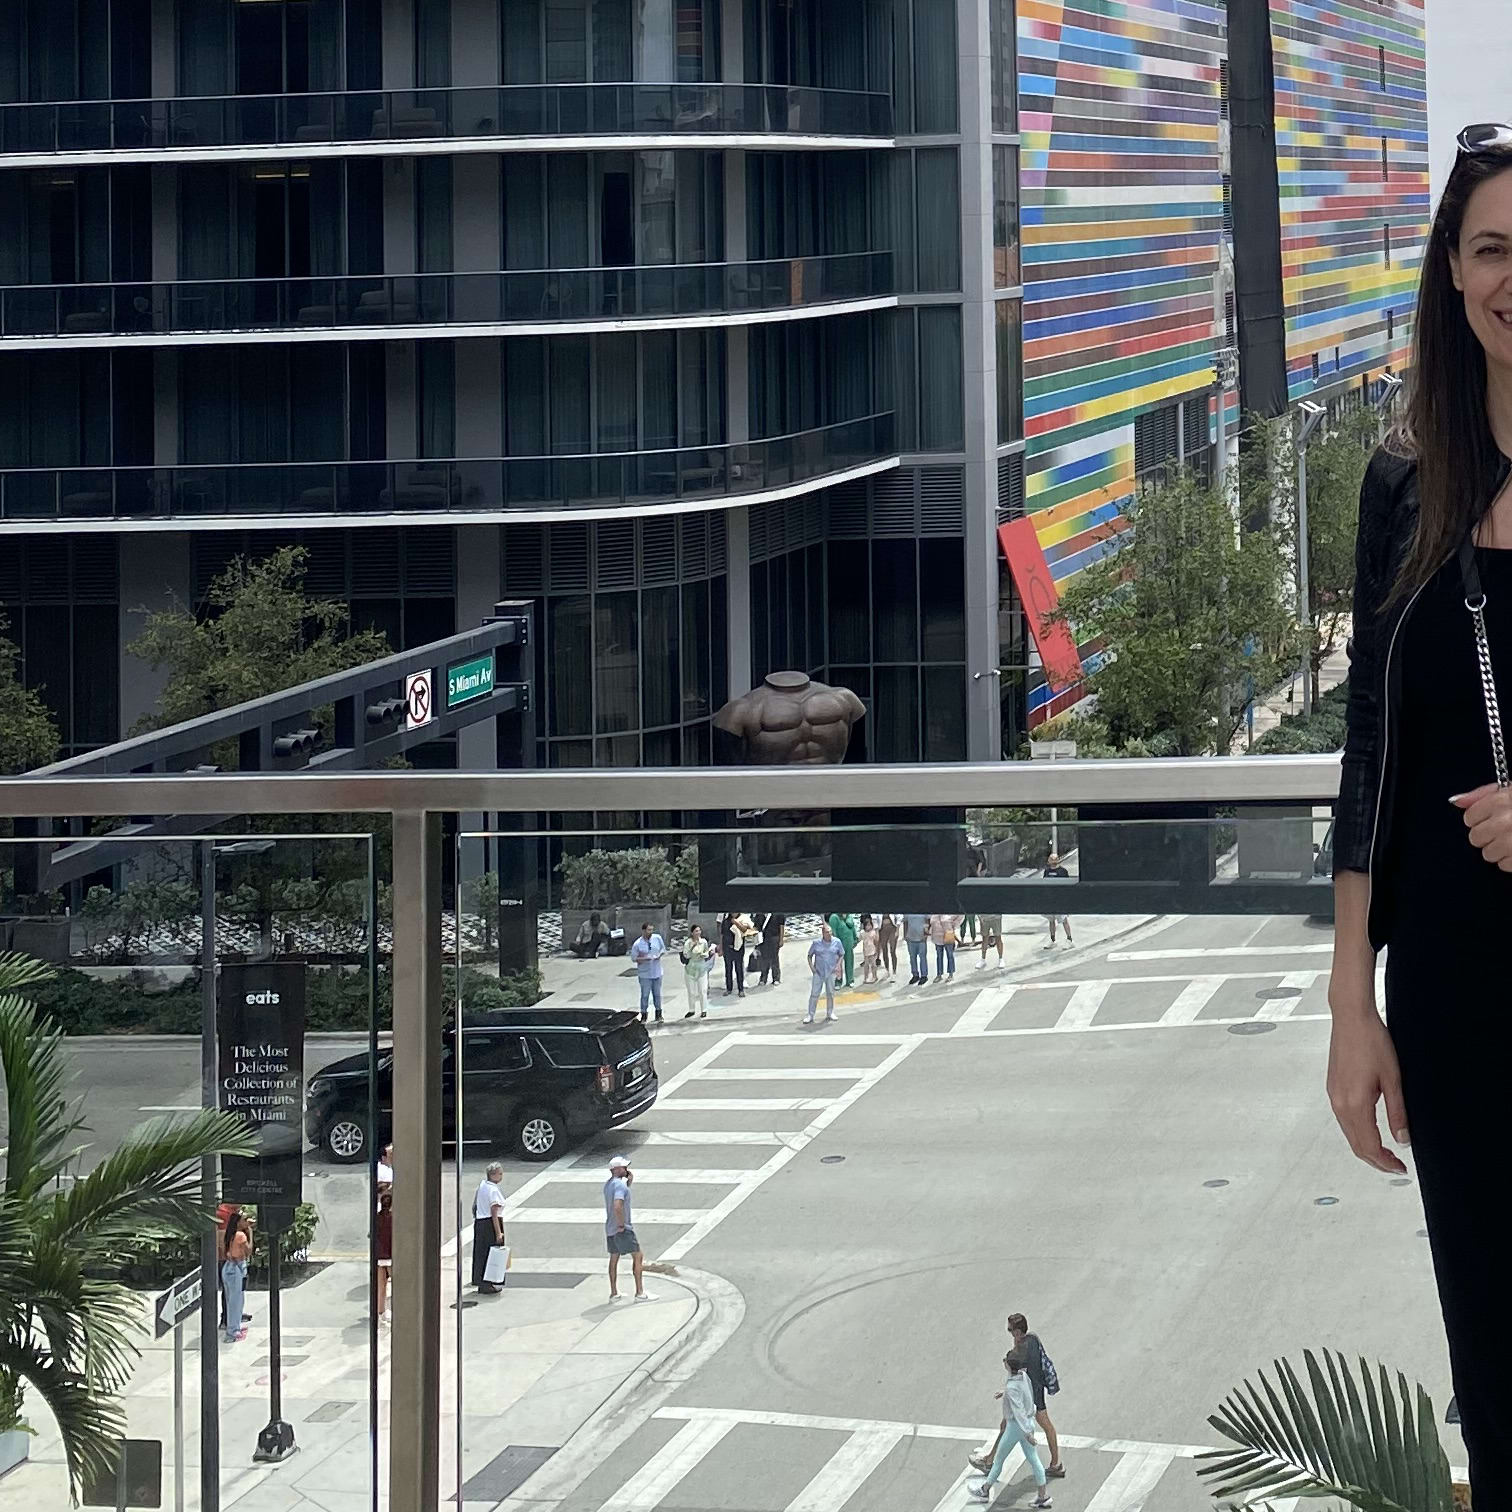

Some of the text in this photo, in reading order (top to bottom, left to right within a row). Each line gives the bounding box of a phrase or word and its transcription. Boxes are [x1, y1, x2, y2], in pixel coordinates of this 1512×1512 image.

[449, 667, 492, 696] S Miami Av
[245, 990, 280, 1005] eats
[231, 1044, 289, 1058] The Most
[235, 1060, 289, 1074] Delicious
[223, 1076, 299, 1090] Collection of
[227, 1093, 295, 1106] Restaurants
[235, 1108, 287, 1121] in Miami
[174, 1290, 190, 1312] ONE
